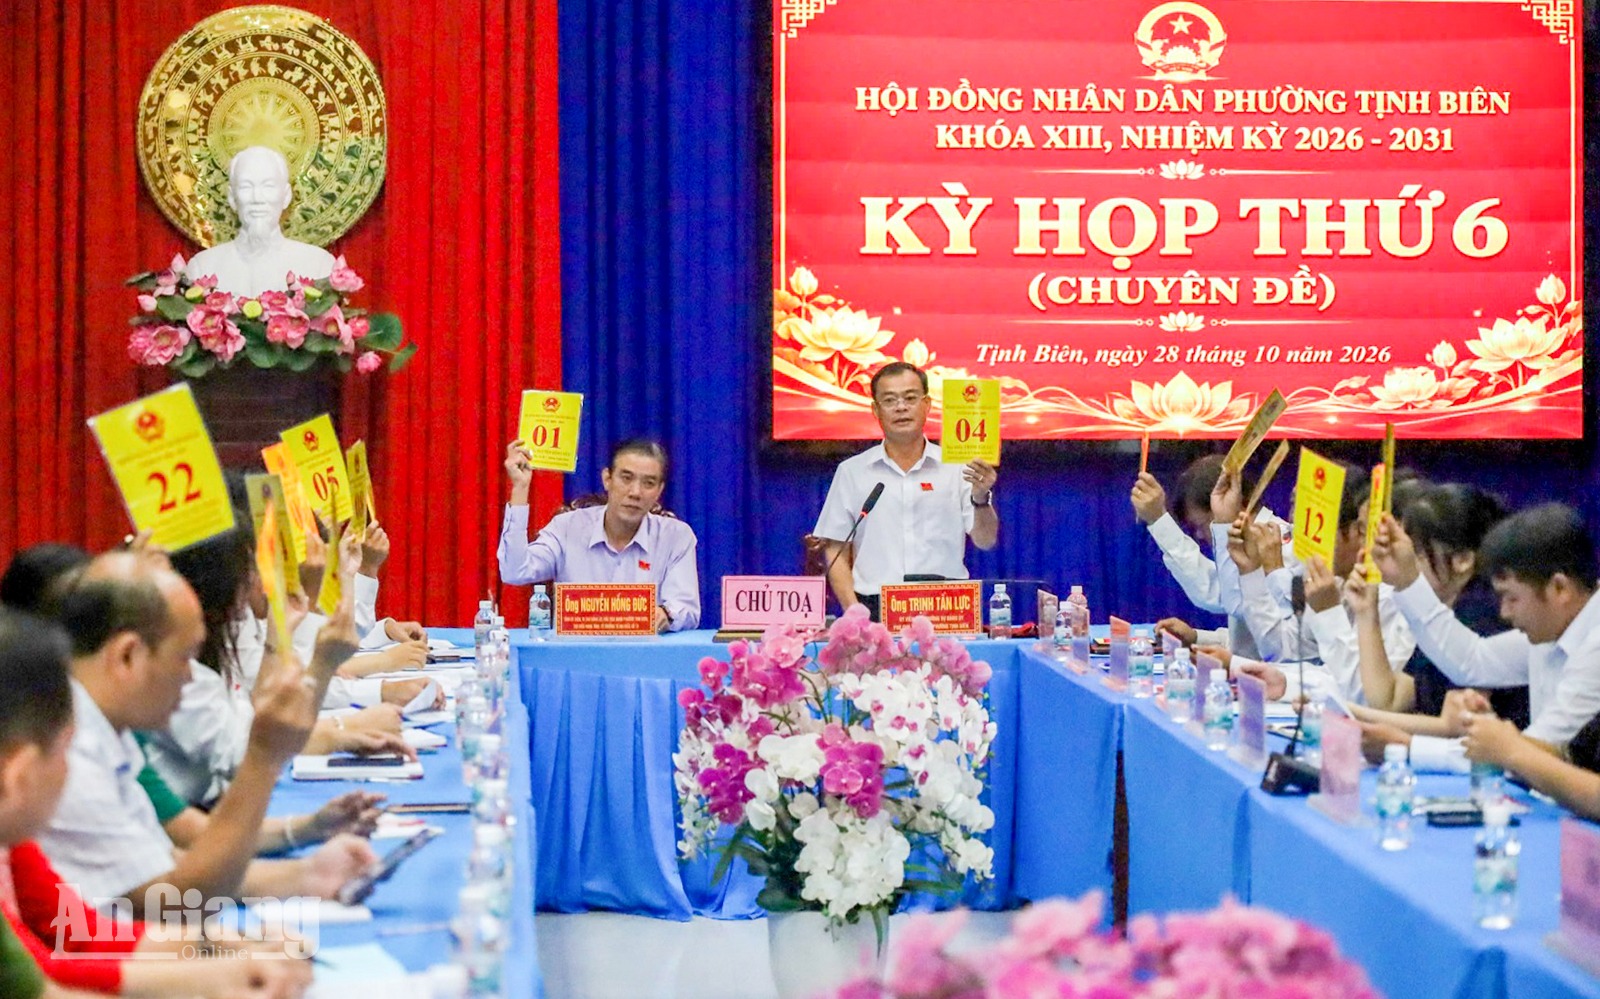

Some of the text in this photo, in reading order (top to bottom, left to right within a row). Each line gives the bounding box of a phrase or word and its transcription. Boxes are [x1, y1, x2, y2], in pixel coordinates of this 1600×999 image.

[855, 78, 1511, 118] HỘI ĐỒNG NHÂN DÂN PHƯỜNG TỊNH BIÊN
[935, 119, 1035, 149] KHÓA
[1042, 125, 1113, 153] XIII,
[1121, 120, 1234, 154] NHIỆM
[1241, 121, 1288, 150] KỲ
[1294, 127, 1364, 150] 2026
[1389, 127, 1454, 150] 2031
[860, 182, 1508, 270] KỲ HỌP THỨ 6
[1028, 265, 1336, 311] (CHUYÊN ĐỀ)
[976, 344, 1391, 367] Tịnh Biên, ngày 28 tháng 10 năm 2026
[532, 425, 561, 449] 01
[956, 418, 987, 443] 04
[146, 463, 201, 514] 22
[313, 466, 340, 501] 05
[1304, 507, 1324, 544] 12
[735, 583, 813, 618] CHỦ TOẠ
[890, 595, 907, 612] Ông
[909, 596, 934, 614] TRỊNH
[954, 595, 971, 613] LỰC
